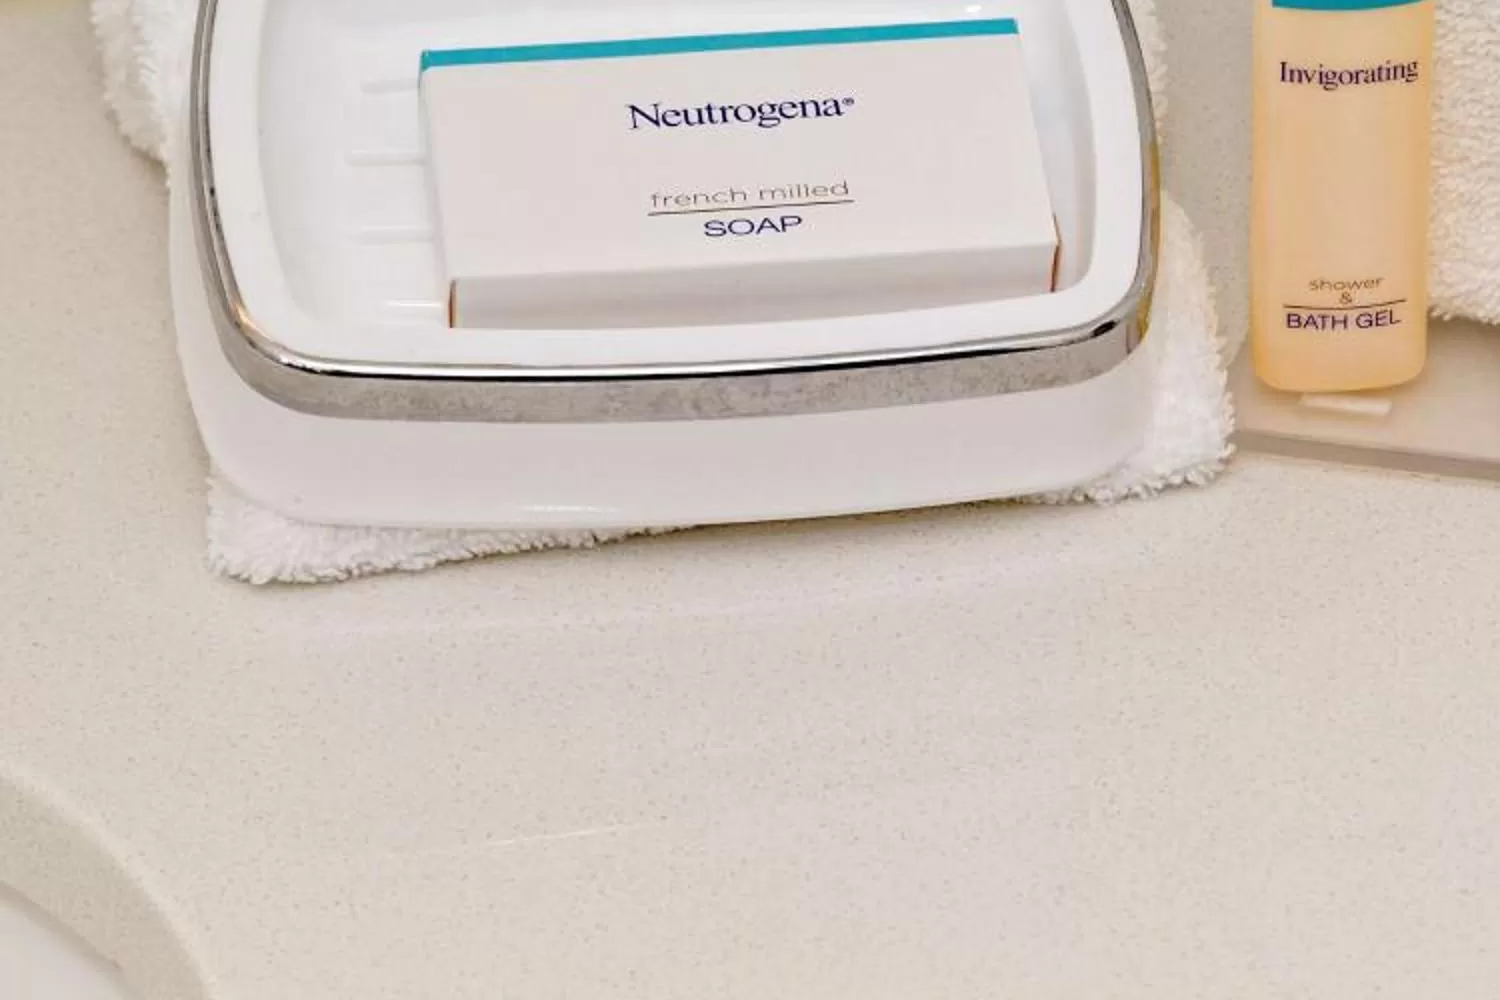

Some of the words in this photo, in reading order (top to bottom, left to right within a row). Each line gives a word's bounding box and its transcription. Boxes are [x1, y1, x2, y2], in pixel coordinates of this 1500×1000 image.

[1280, 60, 1418, 91] Invigorating
[650, 188, 747, 209] french
[758, 180, 850, 201] milled
[703, 215, 802, 238] SOAP
[1309, 277, 1384, 291] shower
[1340, 292, 1352, 305] &
[1287, 313, 1349, 330] BATH
[1355, 309, 1401, 329] GEL
